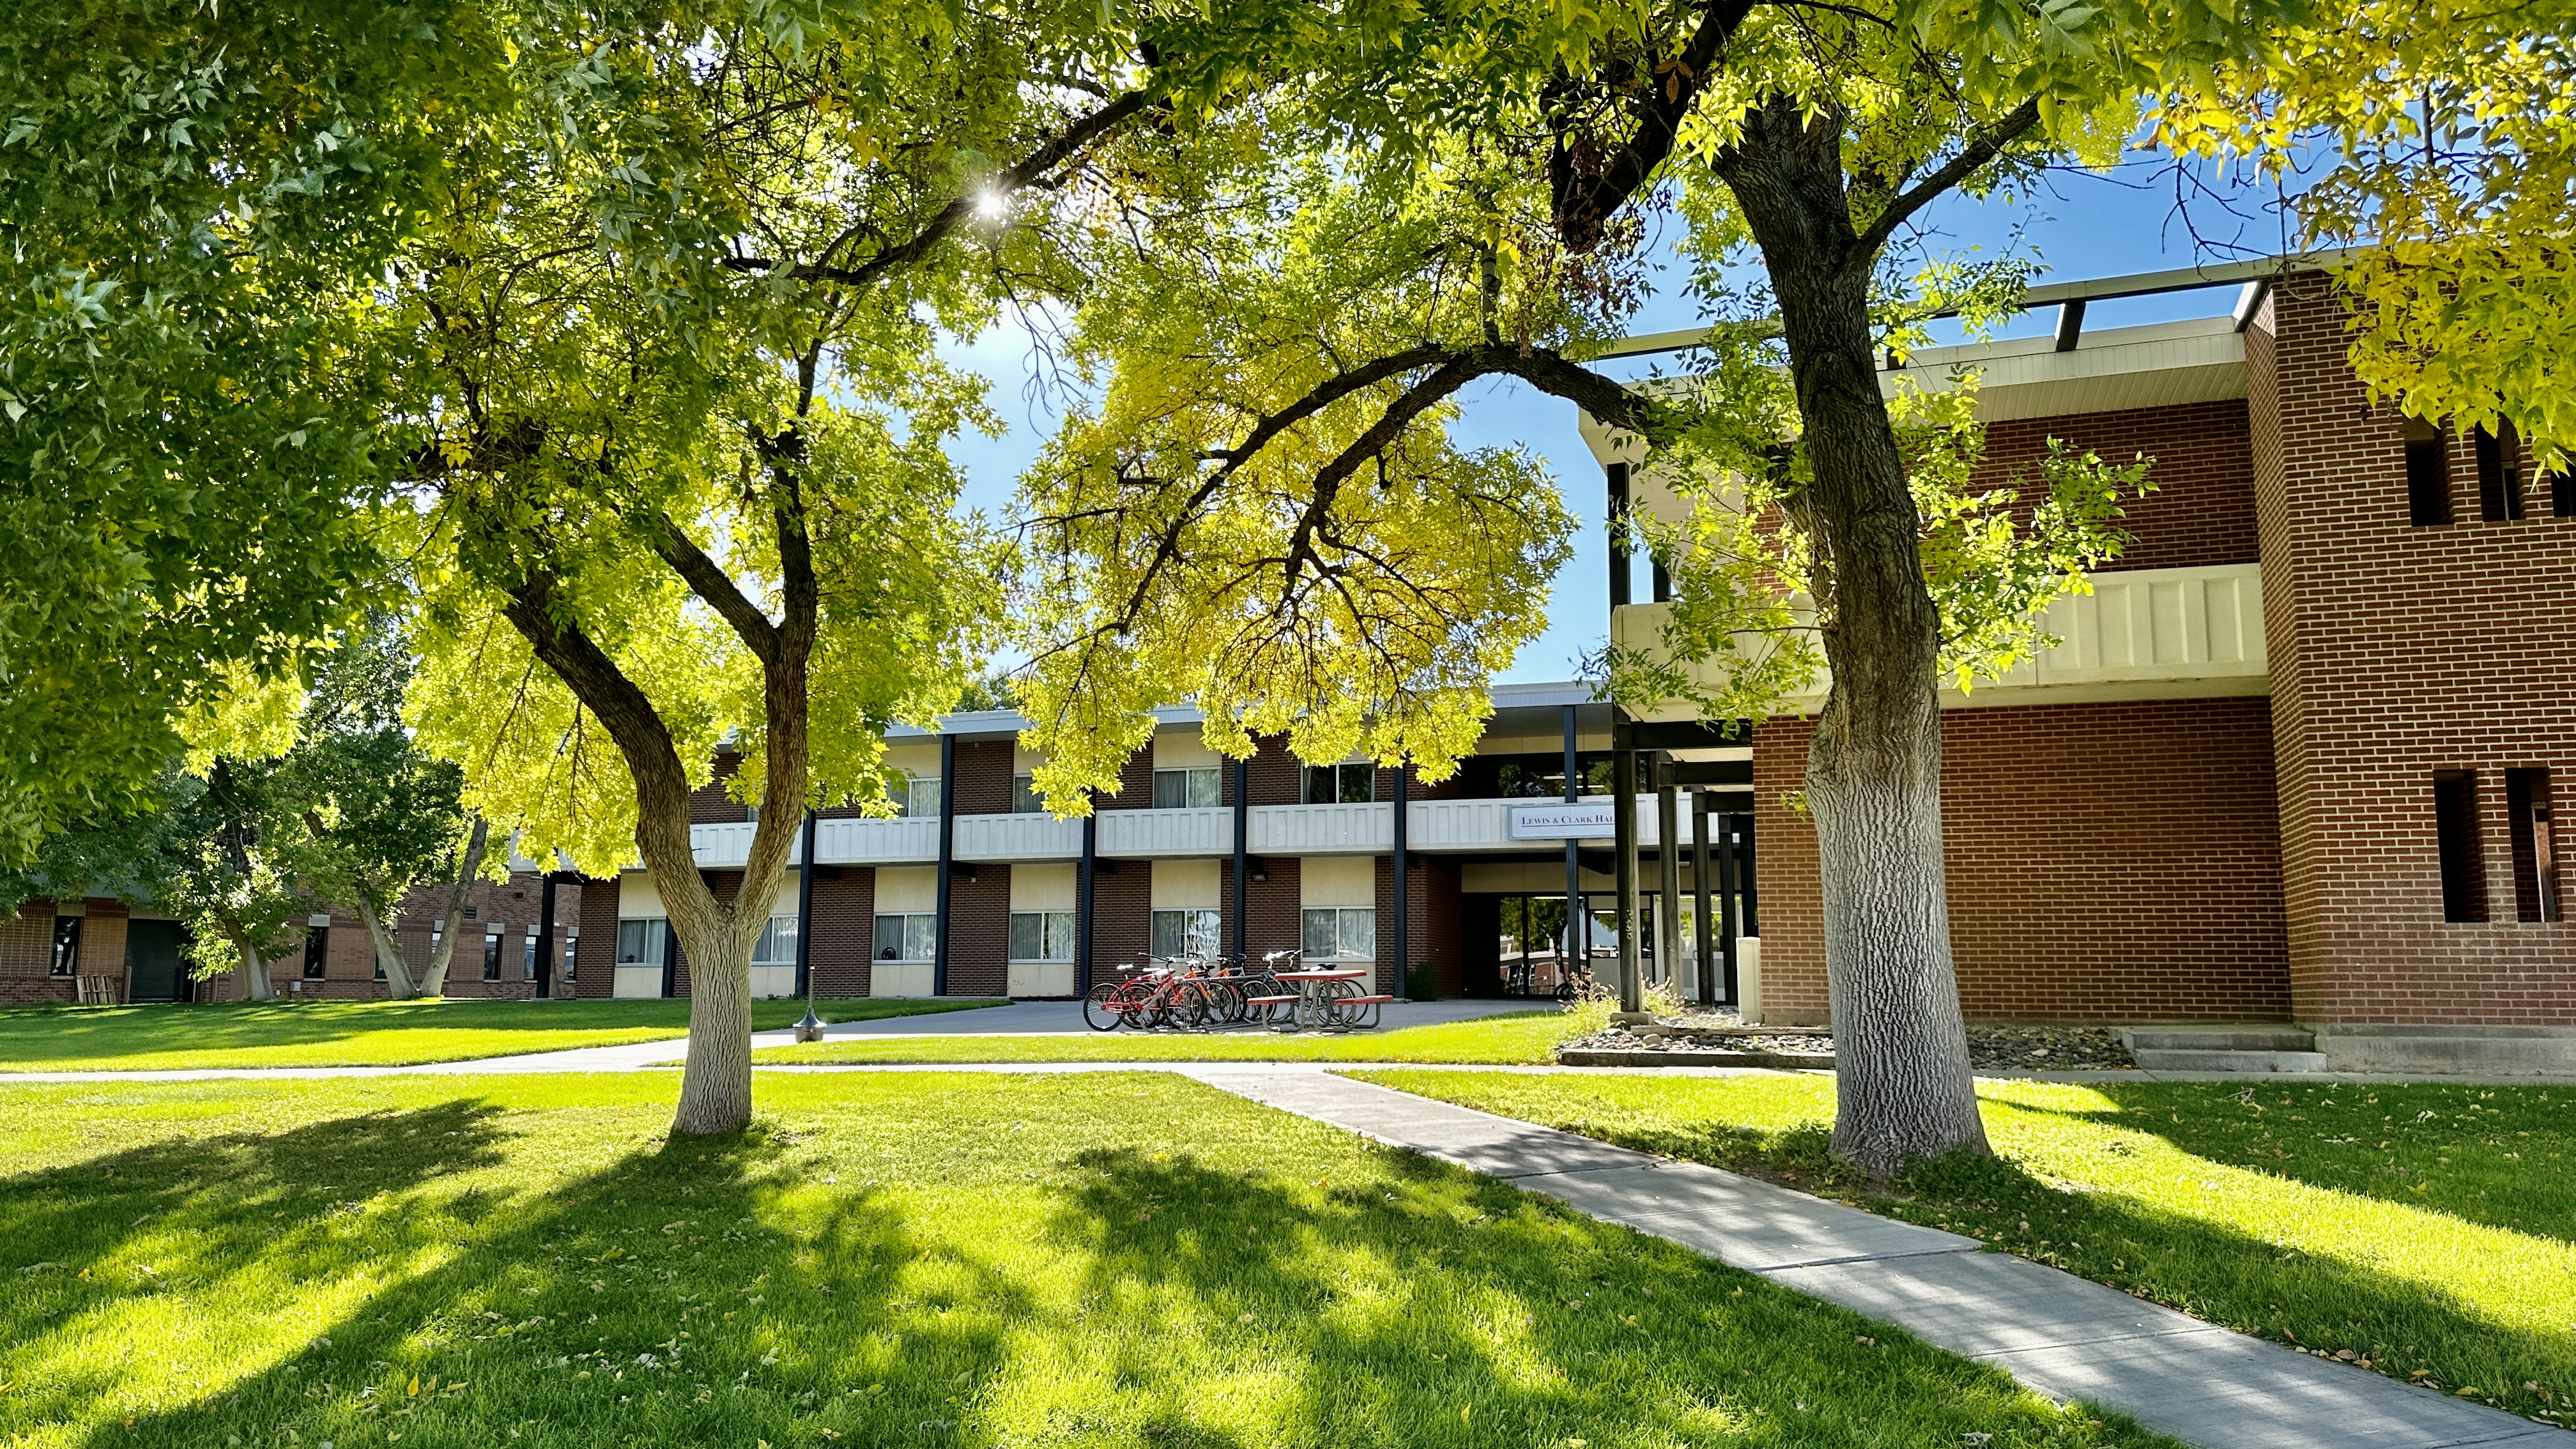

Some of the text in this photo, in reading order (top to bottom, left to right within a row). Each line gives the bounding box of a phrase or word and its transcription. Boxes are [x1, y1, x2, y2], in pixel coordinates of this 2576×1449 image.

[1522, 816, 1550, 825] LEWIS
[1561, 815, 1593, 824] CLARK
[1595, 815, 1615, 823] HAL
